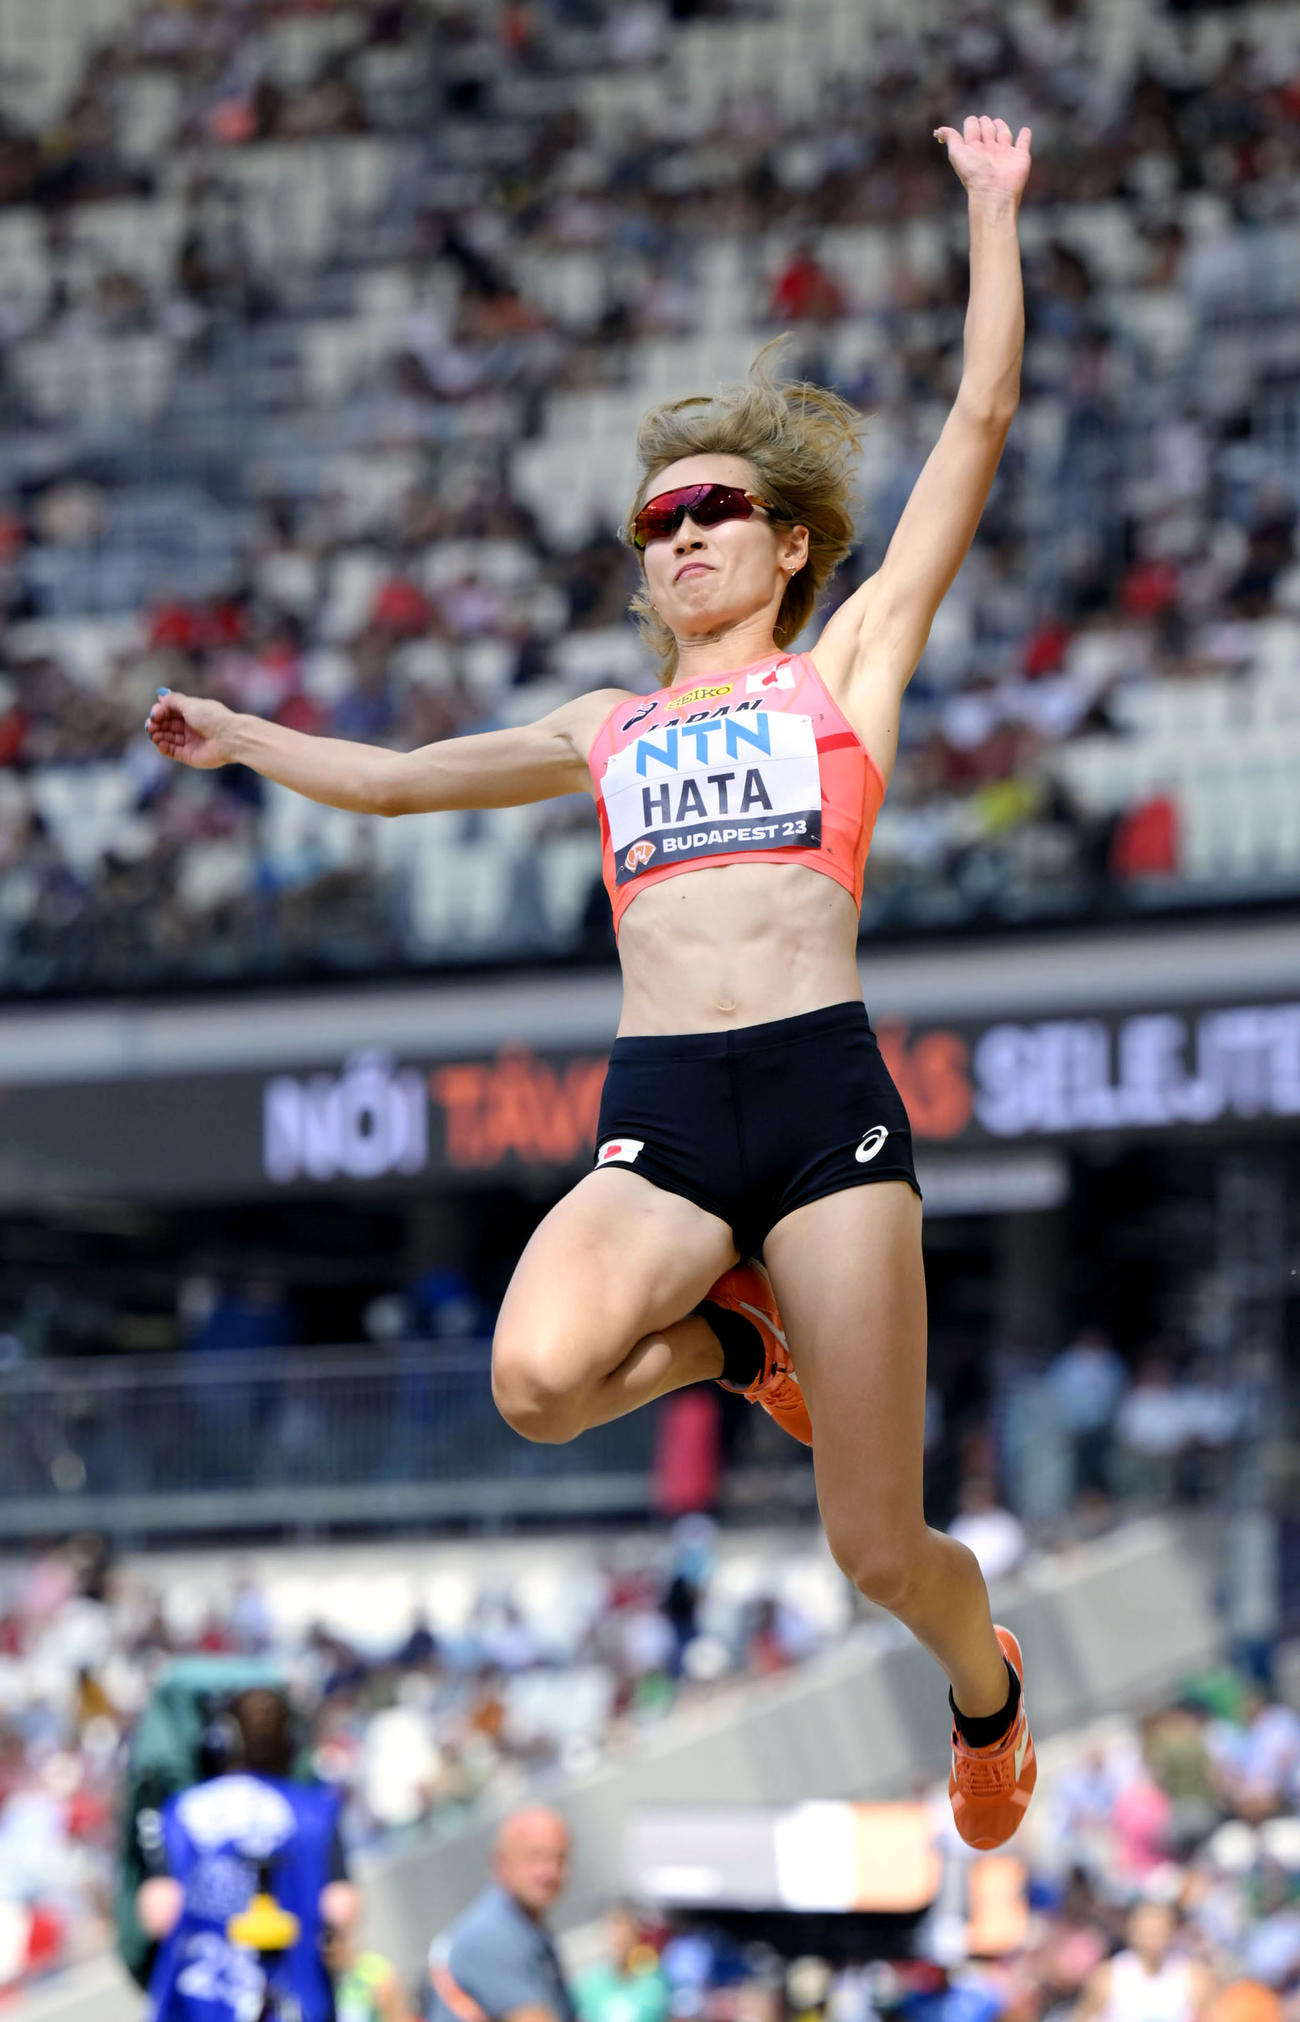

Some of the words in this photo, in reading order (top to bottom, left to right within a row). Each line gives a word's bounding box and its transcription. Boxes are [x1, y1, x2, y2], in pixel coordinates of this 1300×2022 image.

[667, 686, 731, 709] SEIKO
[635, 712, 772, 777] NTN
[641, 768, 773, 828] HATA
[662, 825, 779, 853] BUDAPEST
[782, 820, 808, 836] 23
